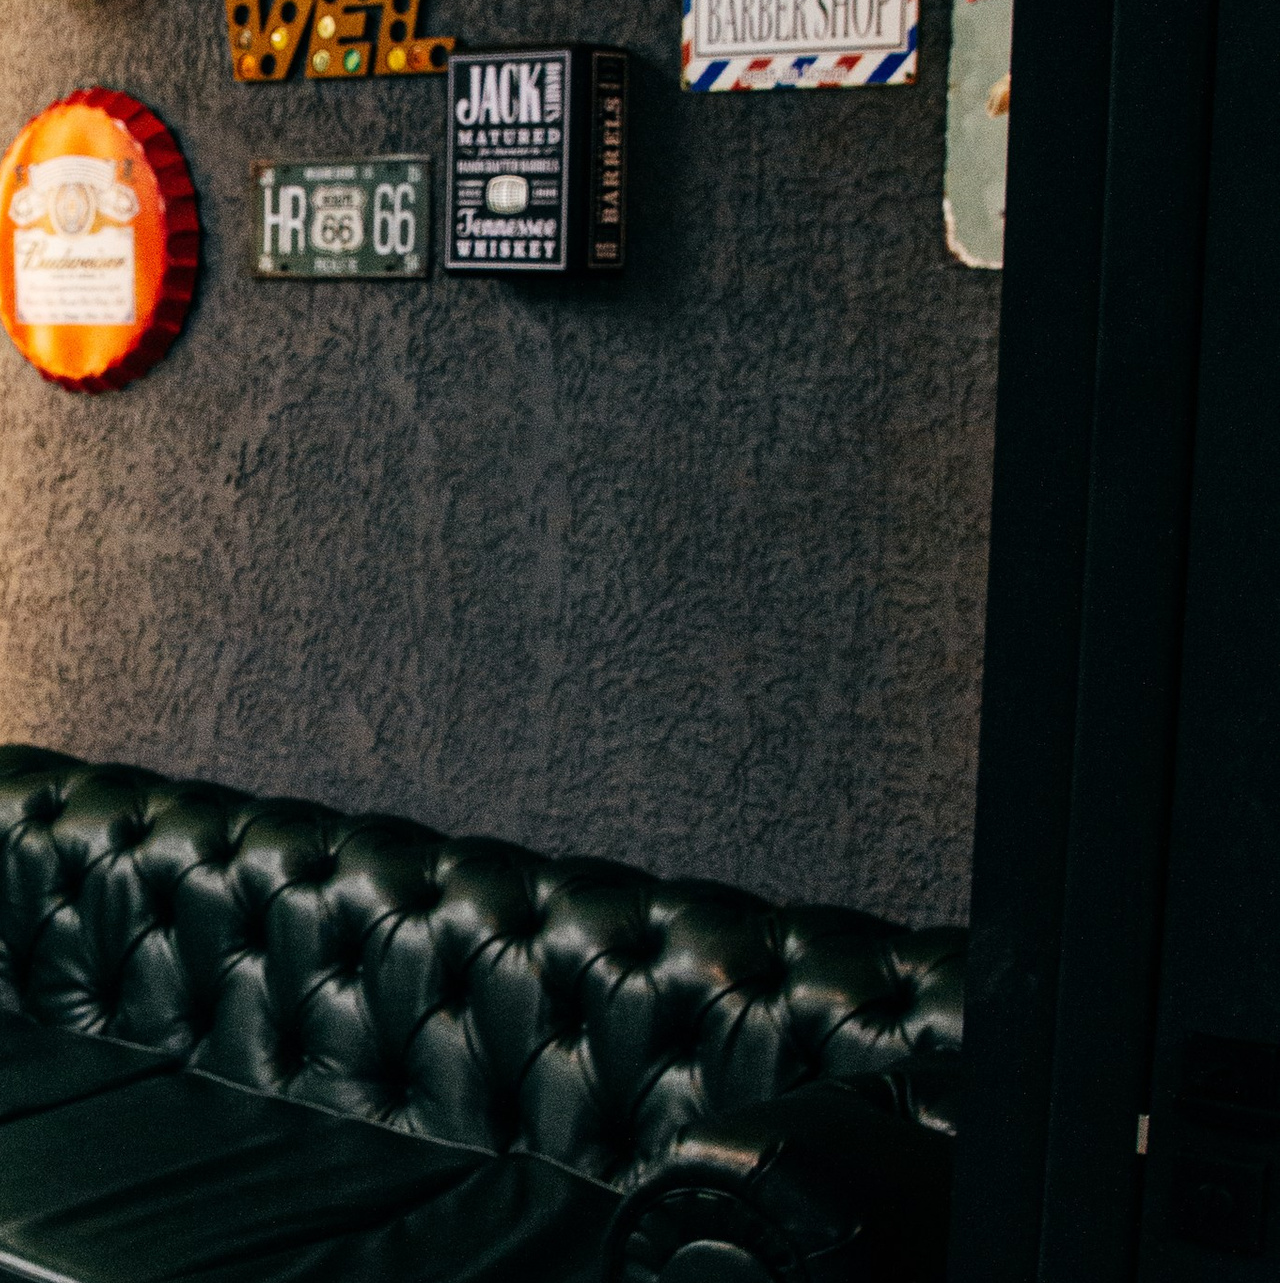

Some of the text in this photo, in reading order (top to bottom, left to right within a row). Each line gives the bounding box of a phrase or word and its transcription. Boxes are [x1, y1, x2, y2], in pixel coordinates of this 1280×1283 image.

[455, 62, 542, 126] JACK
[457, 128, 561, 147] MATURED
[263, 182, 416, 256] HR 66
[321, 215, 354, 244] 66
[456, 240, 557, 259] WHISKEY
